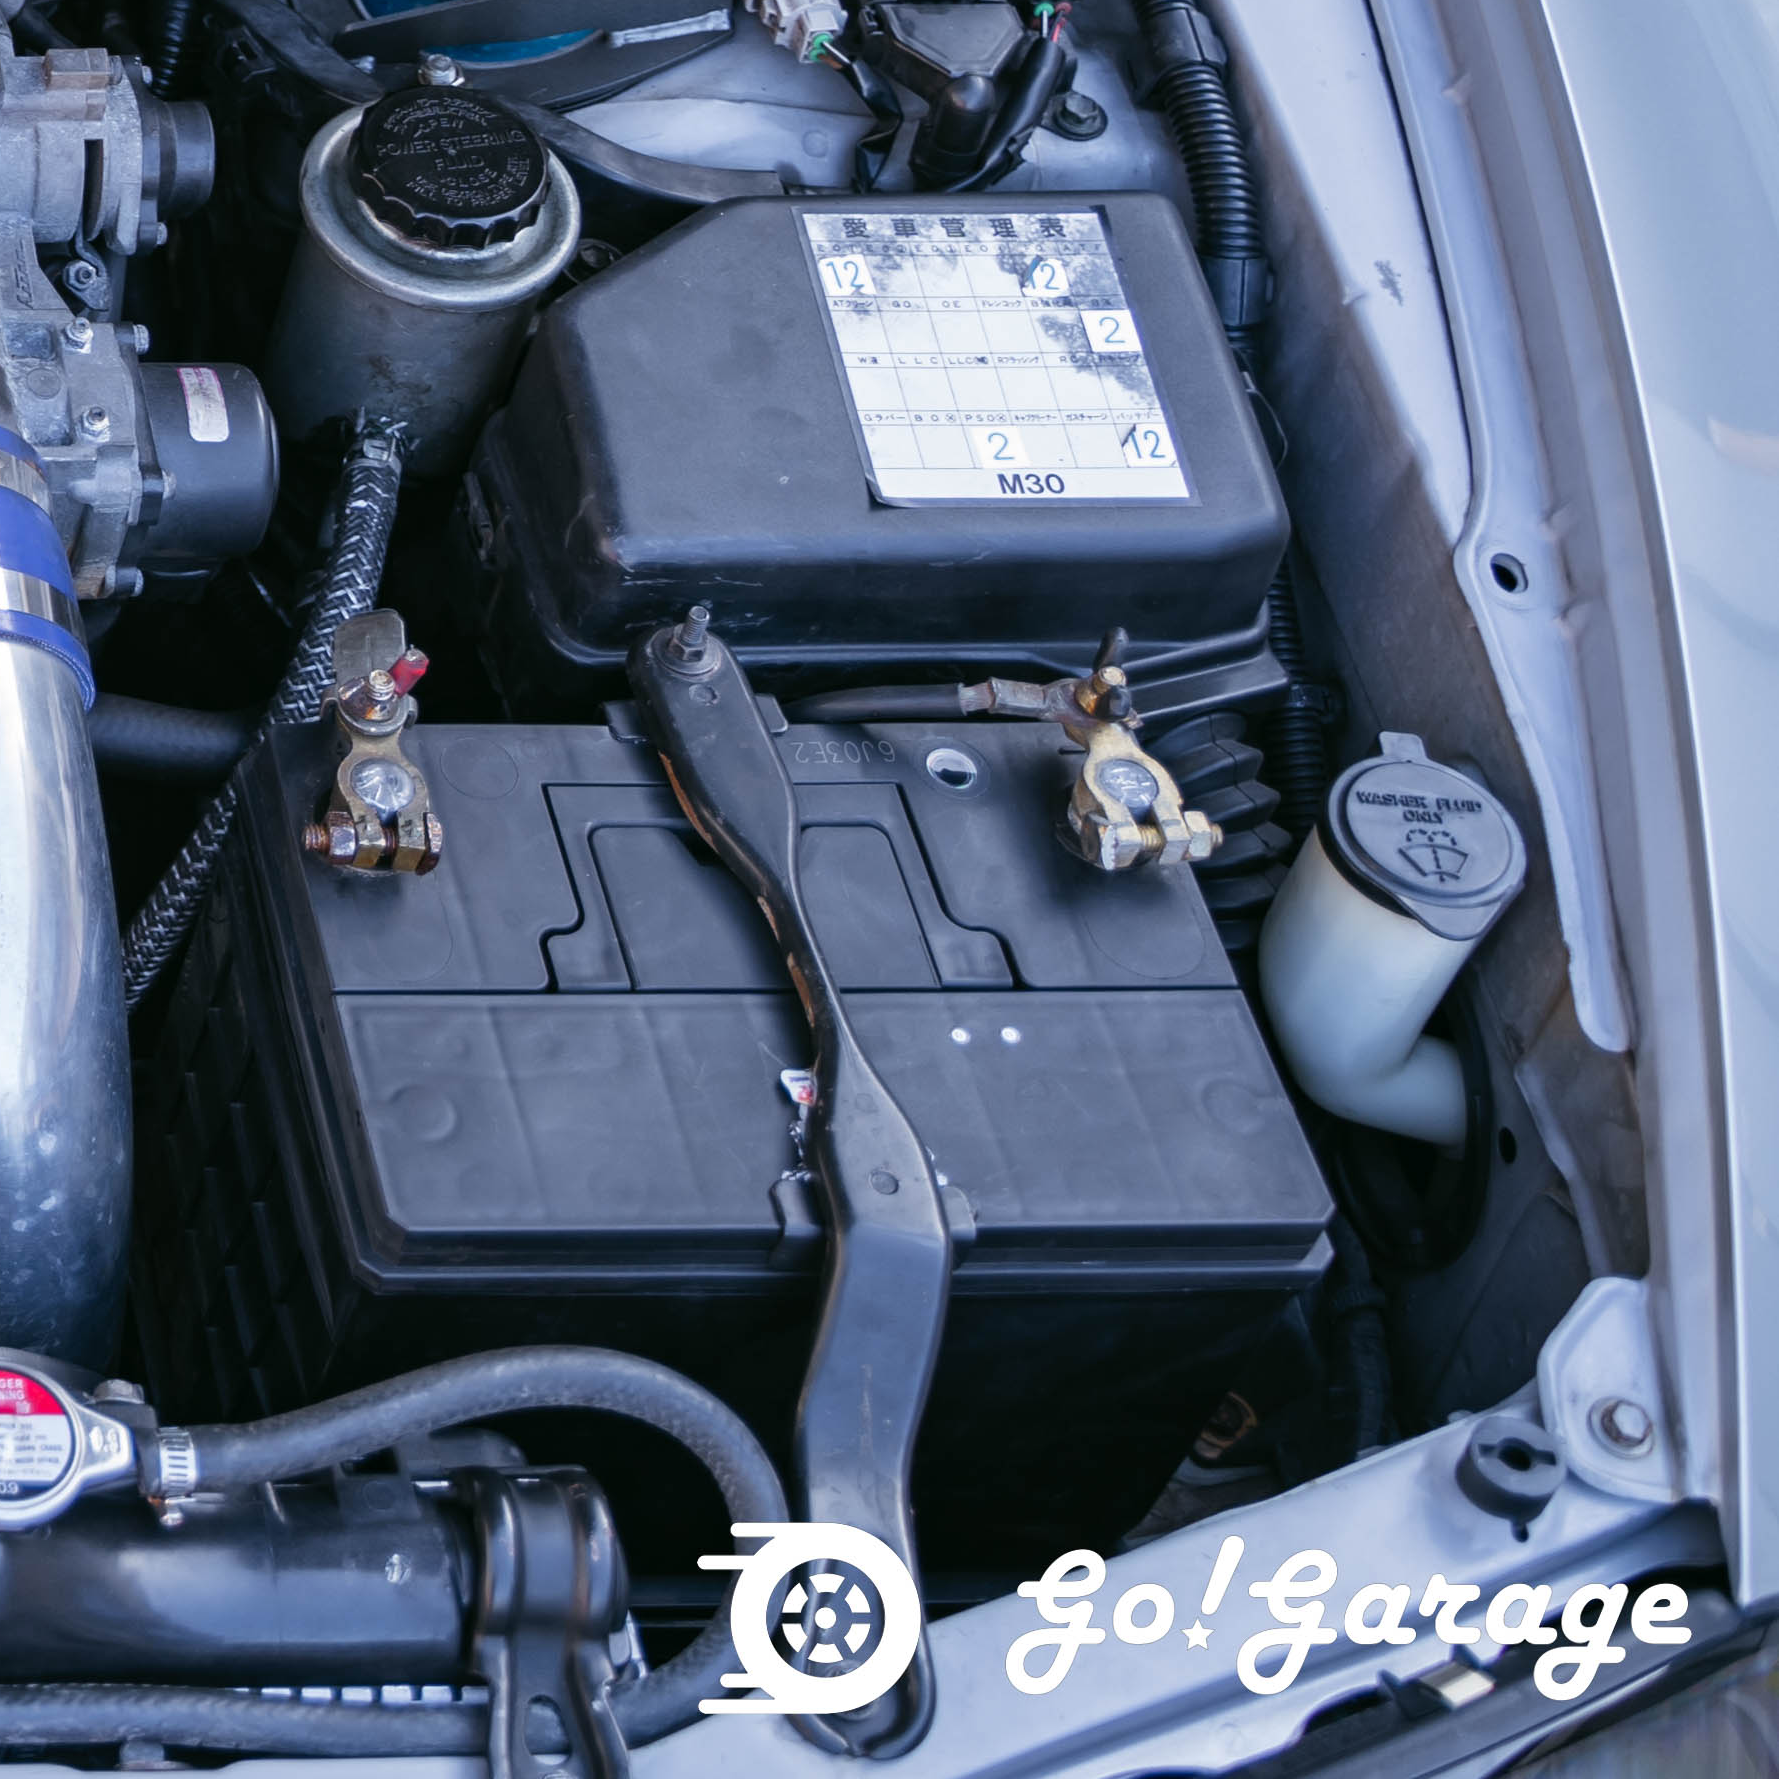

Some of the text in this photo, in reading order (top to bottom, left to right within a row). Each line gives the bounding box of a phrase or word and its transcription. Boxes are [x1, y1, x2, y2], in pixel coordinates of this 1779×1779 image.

[376, 129, 528, 157] POWER STEERING
[434, 154, 486, 172] FLUID
[842, 217, 1066, 239] 愛車管理表
[825, 260, 865, 290] 12
[1098, 316, 1127, 344] 2
[987, 432, 1015, 460] 2
[1128, 429, 1166, 459] 12
[997, 473, 1065, 495] M30
[1355, 790, 1483, 813] WASHER FLUID
[1402, 810, 1444, 825] ONLY
